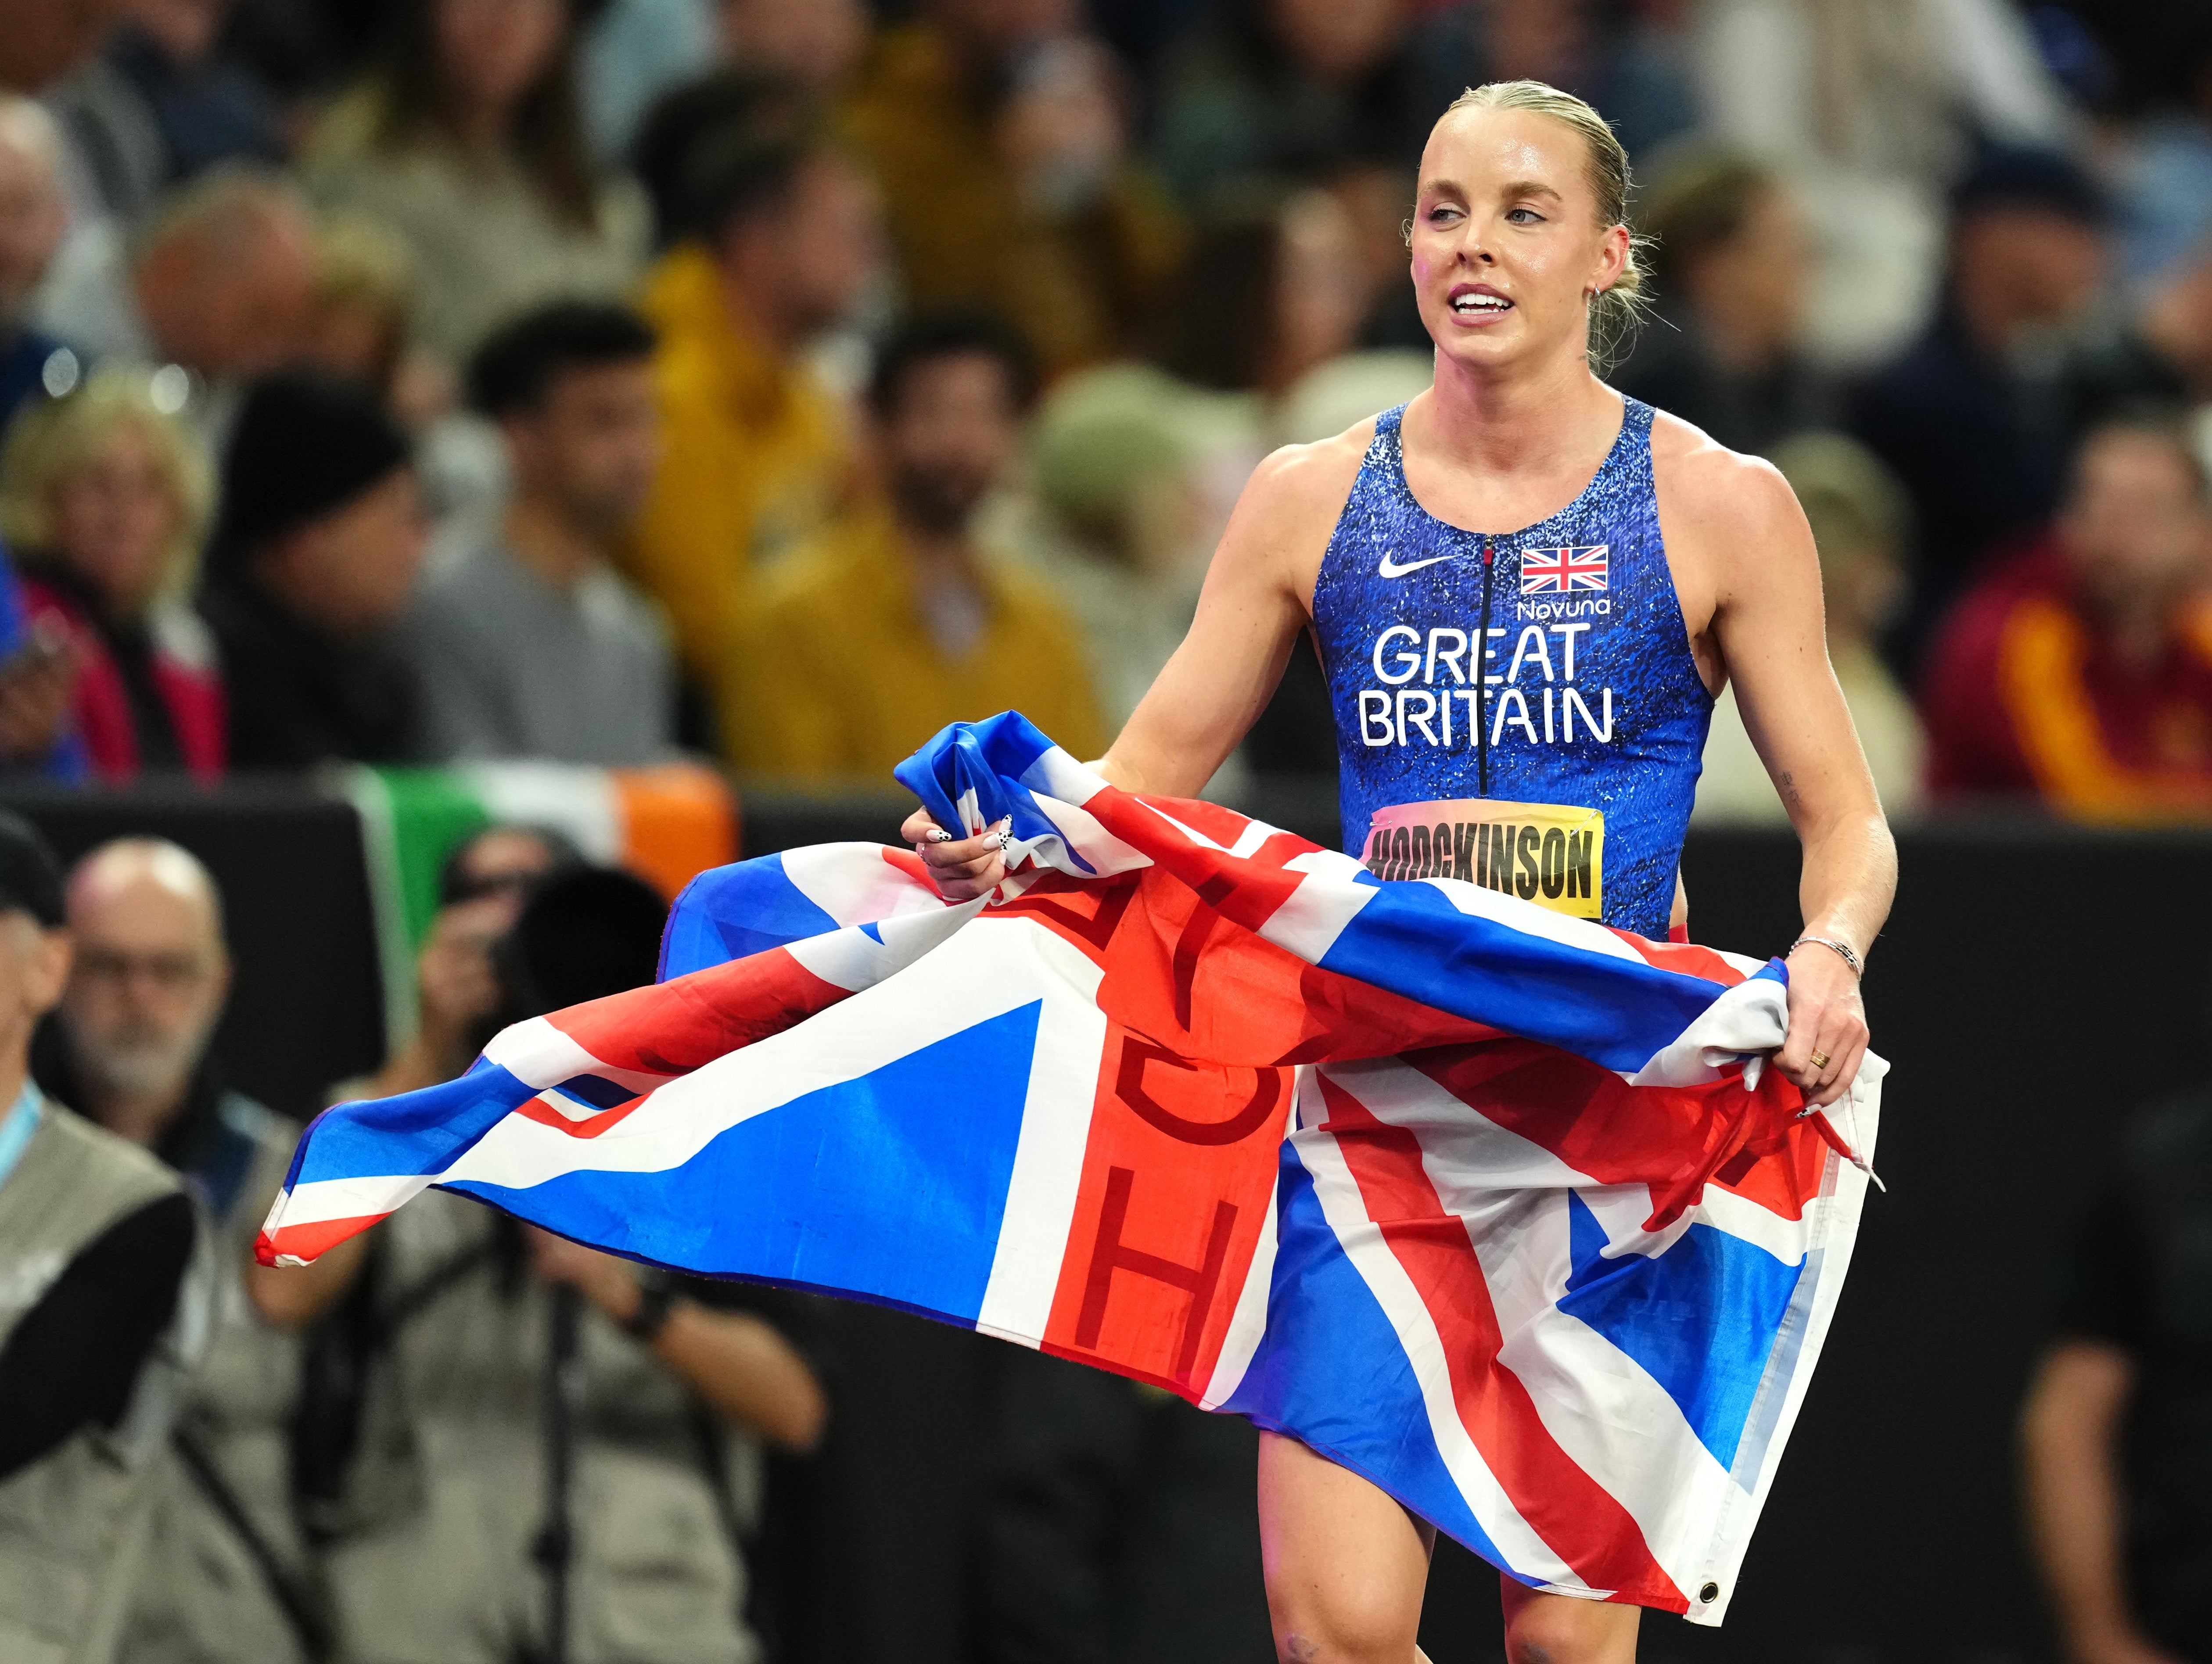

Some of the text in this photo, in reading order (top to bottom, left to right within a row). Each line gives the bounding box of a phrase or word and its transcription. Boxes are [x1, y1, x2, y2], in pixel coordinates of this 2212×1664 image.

[1517, 599, 1611, 621] Novuna
[1373, 623, 1591, 685] GREAT
[1359, 687, 1612, 746] BRITAIN
[1365, 822, 1593, 900] HODGKINSON
